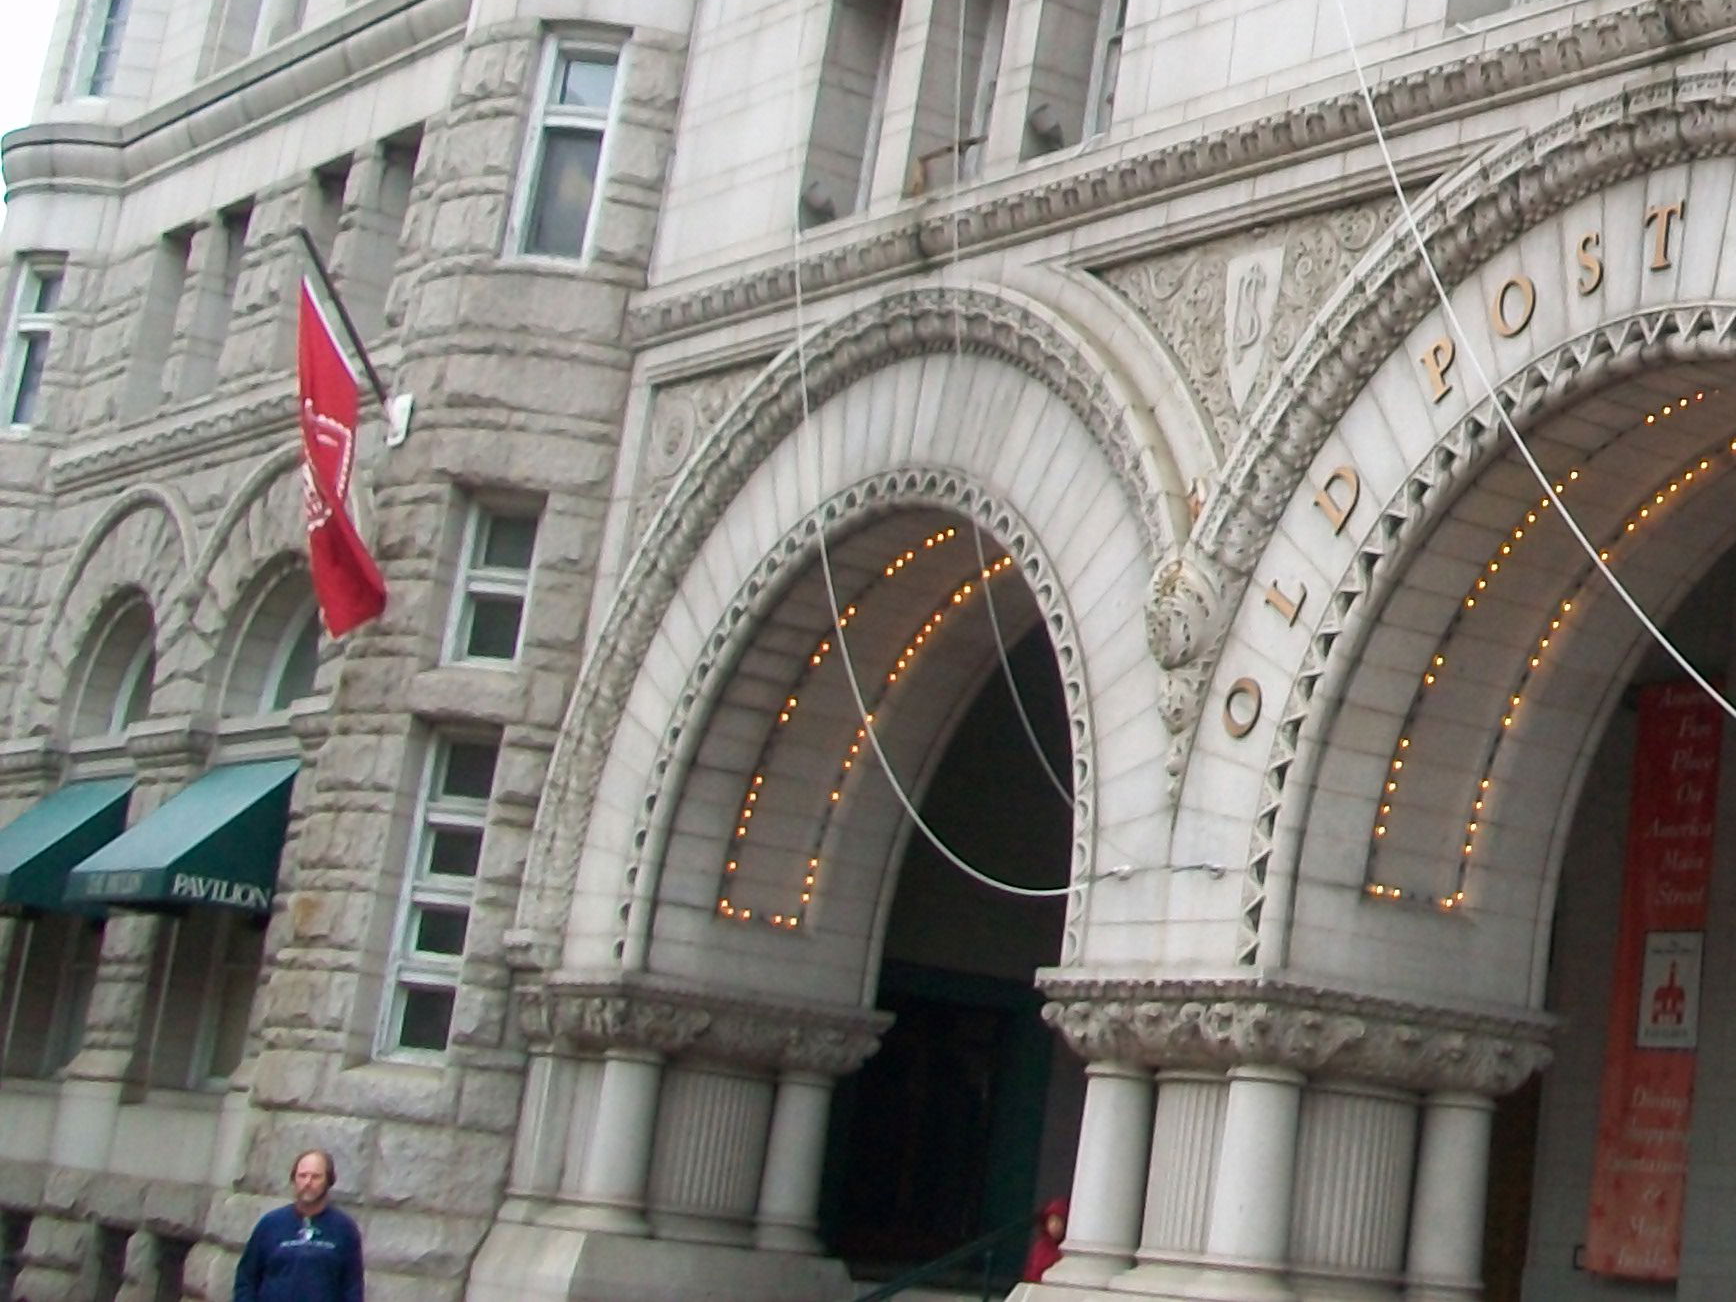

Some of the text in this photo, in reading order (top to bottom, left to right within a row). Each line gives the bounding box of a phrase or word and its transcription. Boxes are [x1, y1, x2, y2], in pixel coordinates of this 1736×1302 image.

[1223, 465, 1361, 740] OLD
[1419, 198, 1685, 404] POST
[172, 871, 272, 909] PAVILION
